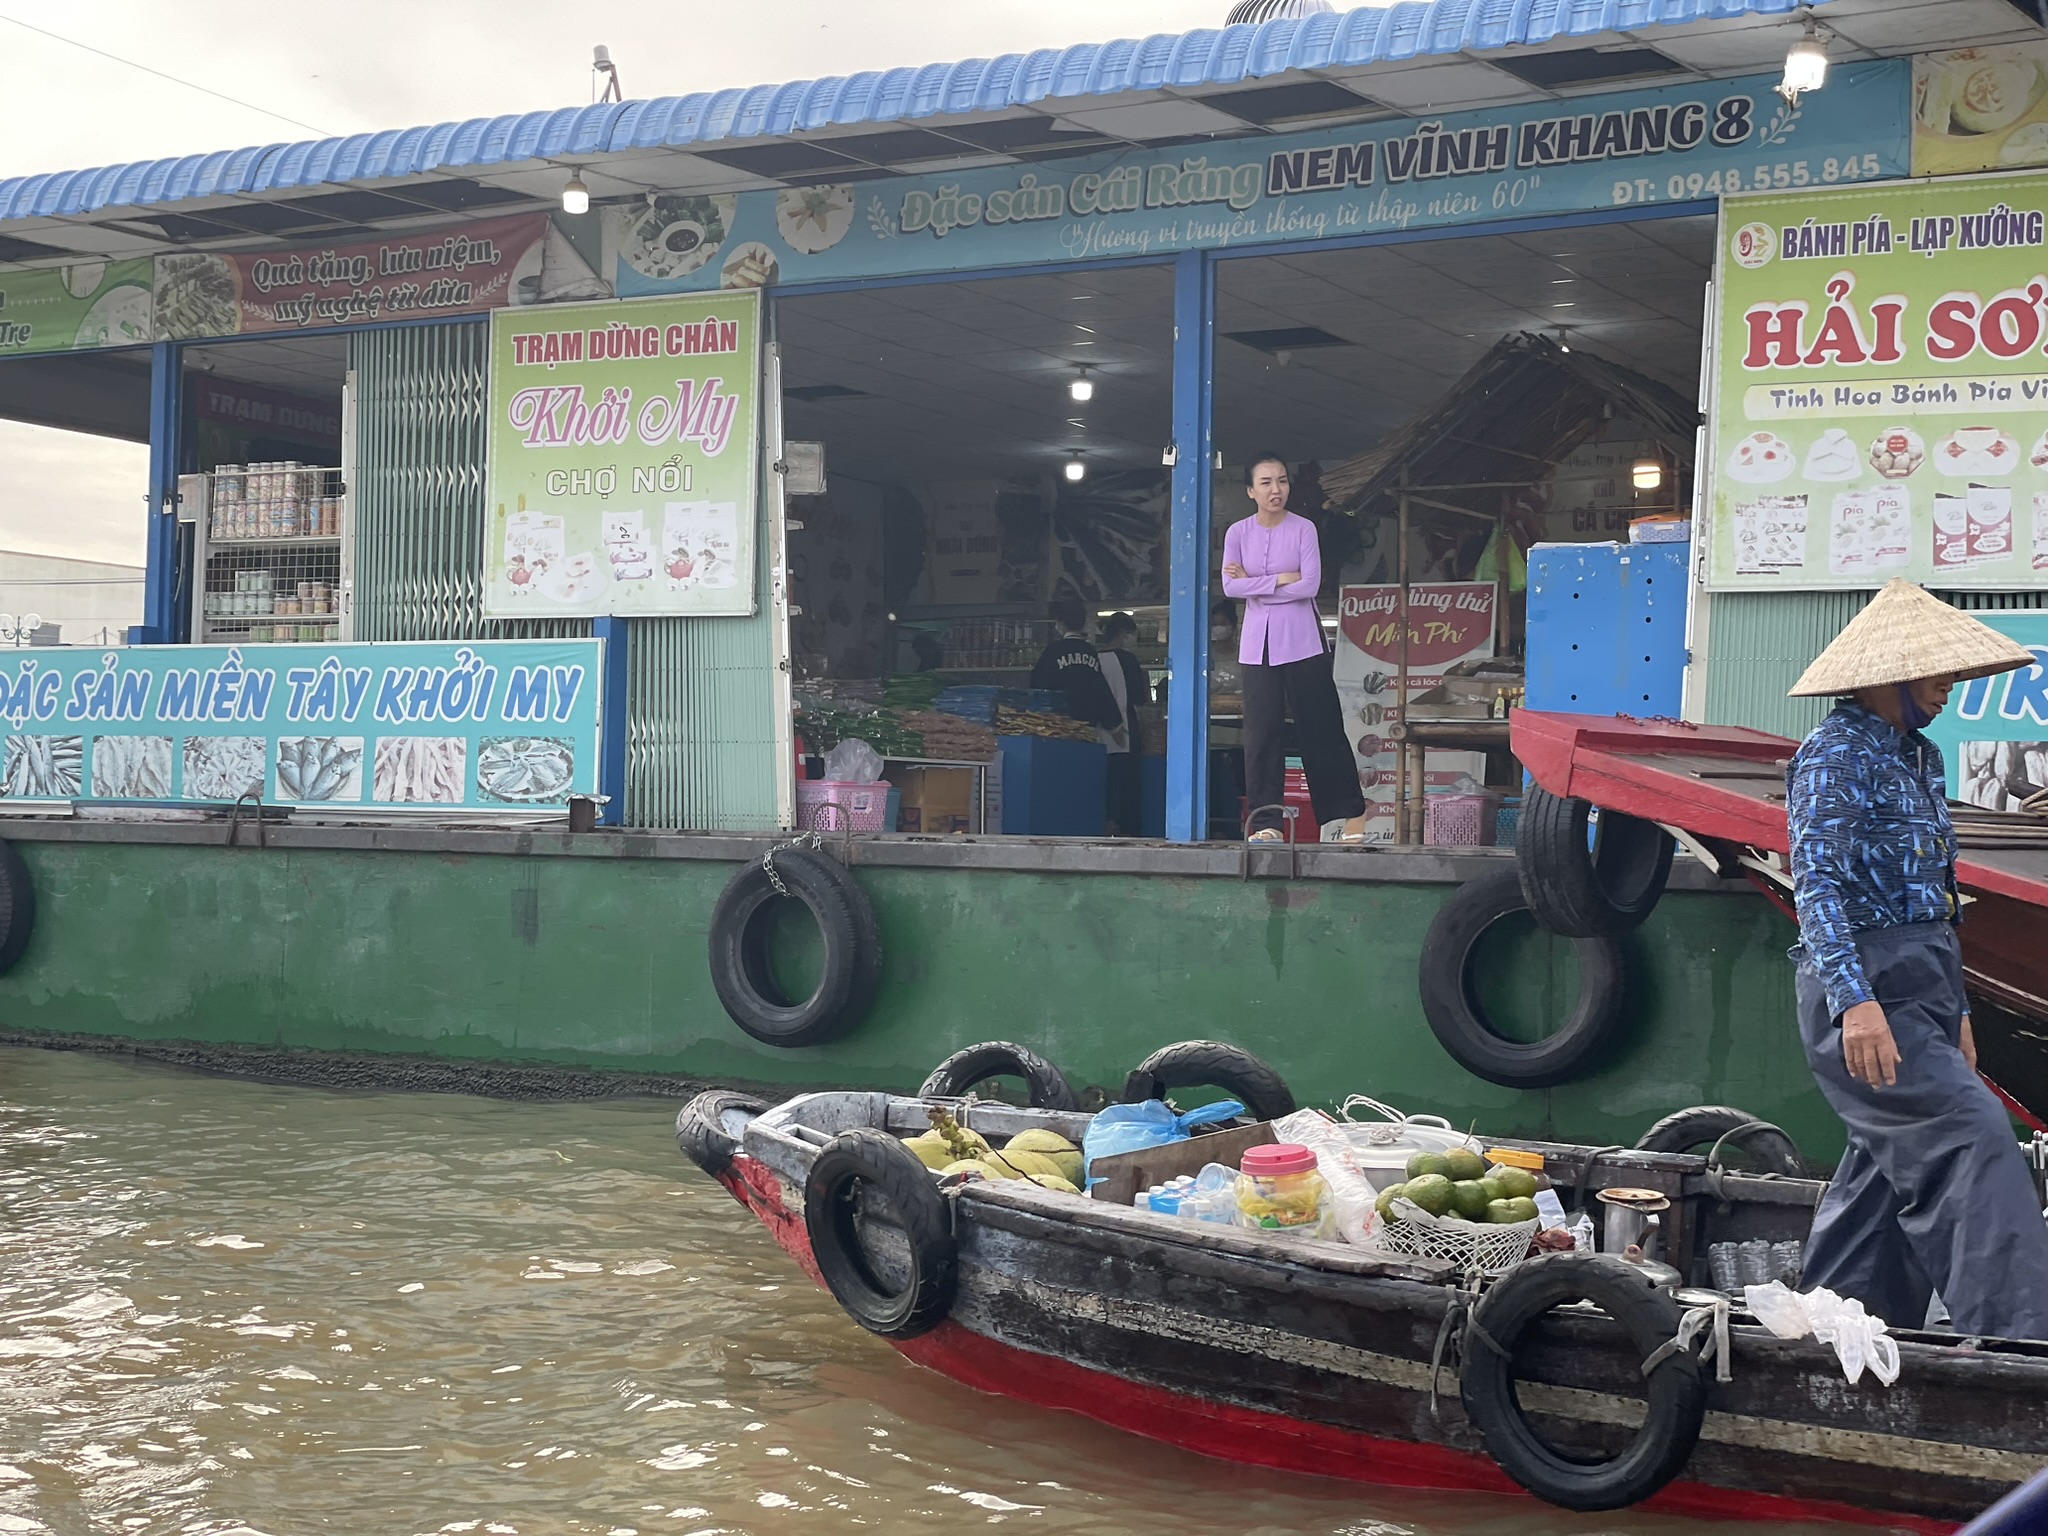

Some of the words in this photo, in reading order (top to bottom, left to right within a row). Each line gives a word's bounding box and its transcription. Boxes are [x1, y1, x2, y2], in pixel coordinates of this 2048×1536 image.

[901, 184, 983, 237] Đặc
[986, 174, 1063, 224] sản
[1069, 167, 1142, 215] Cái
[1146, 156, 1263, 209] Răng
[1267, 140, 1375, 196] NEM
[1384, 121, 1511, 183] VĨNH
[1516, 101, 1707, 169] KHANG
[1714, 95, 1754, 143] 8
[1612, 178, 1656, 205] ĐT:
[1667, 153, 1881, 200] 0948.555.845
[1186, 211, 1260, 247] truyền
[1266, 198, 1329, 240] thống
[1336, 202, 1360, 226] từ
[1427, 191, 1482, 216] niên
[1781, 217, 1846, 260] BÁNH
[1851, 213, 1892, 256] PÍA
[1910, 217, 1951, 258] LẠP
[1958, 204, 2043, 250] XƯỞNG
[252, 255, 304, 293] Quà
[308, 250, 374, 287] tặng,
[379, 245, 422, 276] lưu
[426, 234, 501, 272] niệm,
[273, 293, 315, 325] mỹ
[316, 286, 384, 323] nghệ
[386, 283, 419, 311] từ
[419, 277, 472, 308] dừa
[1743, 275, 1906, 370] HẢI
[1925, 276, 2048, 361] SƠ
[512, 331, 583, 369] TRẠM
[588, 321, 660, 361] DỪNG
[665, 316, 738, 356] CHÂN
[508, 385, 631, 447] Khởi
[637, 377, 739, 457] My
[1770, 388, 1823, 409] Tinh
[1834, 387, 1882, 406] Hoa
[1891, 383, 1957, 403] Bánh
[1969, 381, 2011, 401] Pía
[546, 465, 617, 499] CHỢ
[632, 454, 693, 493] NỔI
[1341, 589, 1398, 617] Quầy
[1455, 592, 1492, 613] thử
[1423, 621, 1468, 645] Phí
[64, 652, 151, 721] SẢN
[155, 648, 274, 722] MIỀN
[286, 655, 373, 722] TÂY
[375, 647, 498, 724] KHỞI
[501, 664, 585, 723] MY
